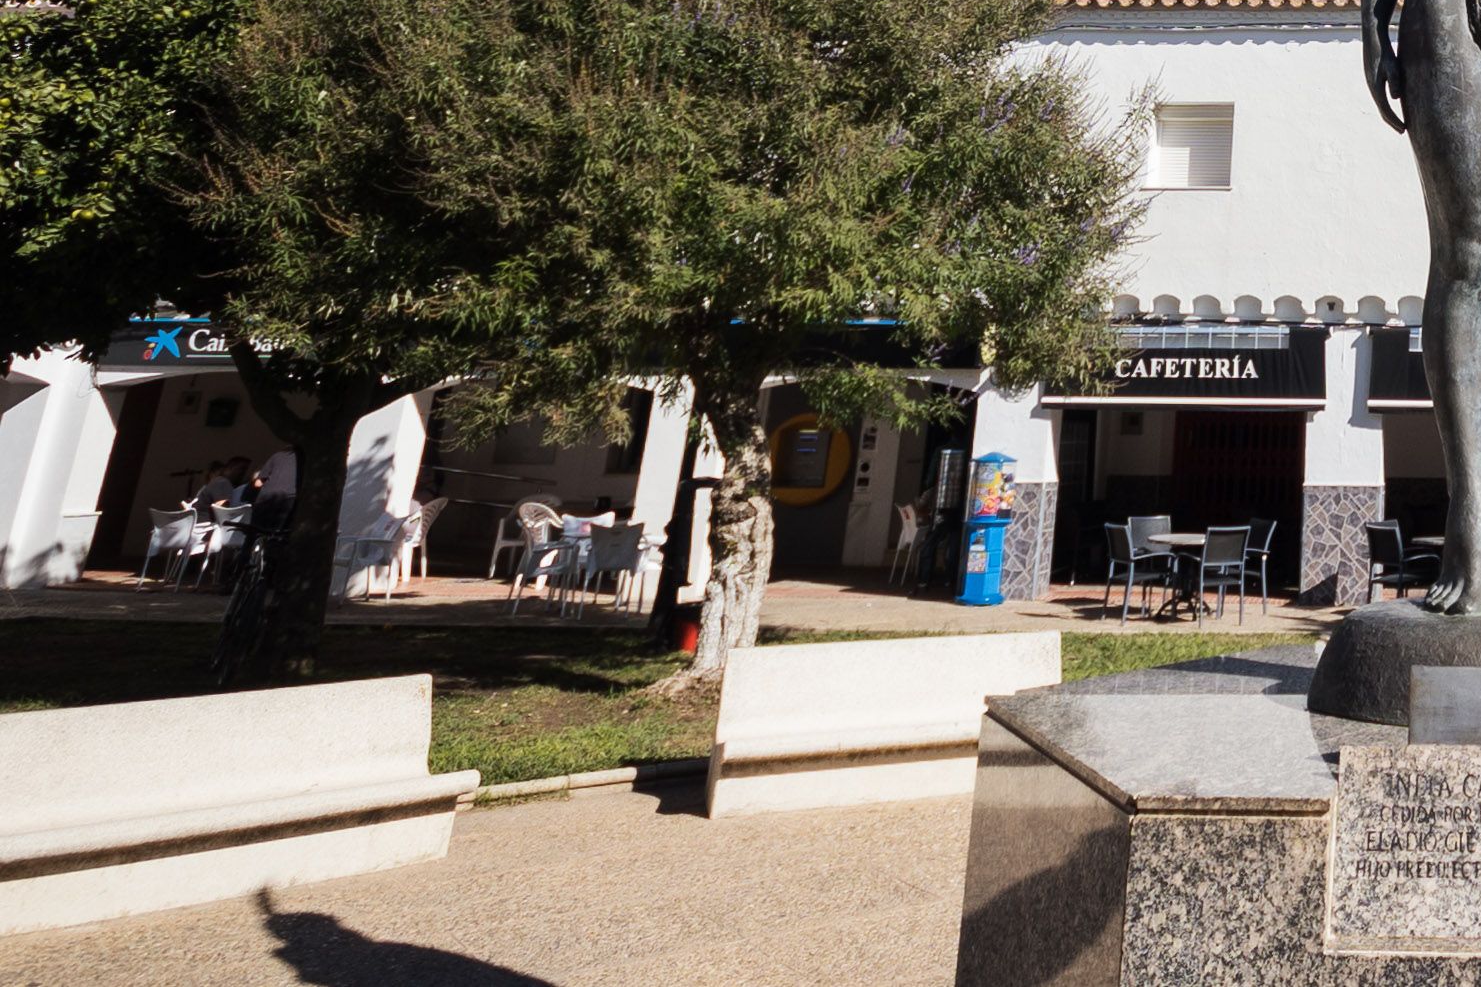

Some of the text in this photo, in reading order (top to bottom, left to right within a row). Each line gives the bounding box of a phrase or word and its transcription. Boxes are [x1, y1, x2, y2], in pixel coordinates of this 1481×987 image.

[1115, 354, 1259, 379] CAFETERÍA
[1444, 805, 1473, 823] POR
[1366, 830, 1438, 853] ELADIO
[1355, 859, 1391, 880] HIJO
